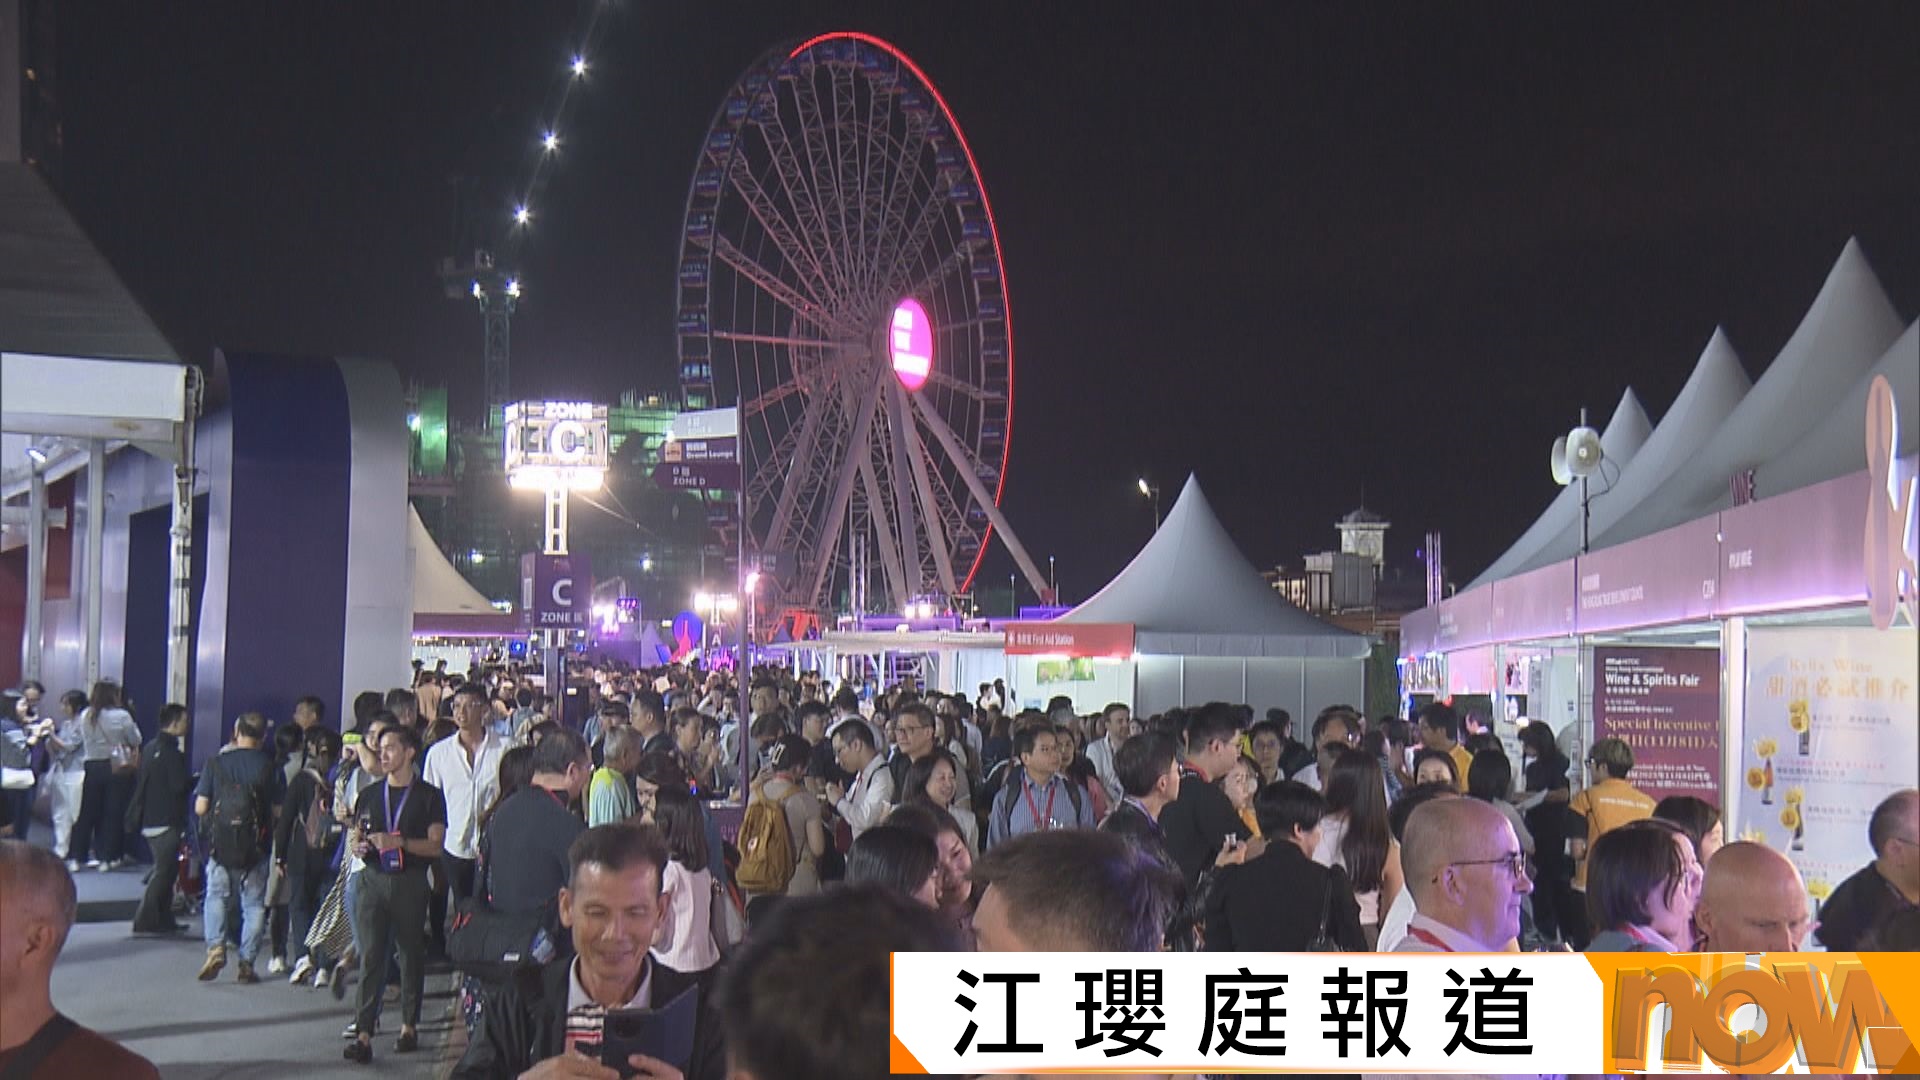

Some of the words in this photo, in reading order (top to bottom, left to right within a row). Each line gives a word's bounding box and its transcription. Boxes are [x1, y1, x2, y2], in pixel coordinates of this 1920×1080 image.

[543, 401, 593, 419] ZONE
[550, 419, 587, 464] C
[672, 477, 698, 487] ZONE
[699, 477, 706, 487] D
[552, 578, 573, 606] C
[541, 612, 571, 624] ZONE
[1032, 632, 1044, 646] First
[1045, 632, 1054, 646] Aid
[1055, 633, 1074, 646] Station
[1605, 674, 1630, 686] Wine
[1632, 674, 1641, 686] &
[1643, 674, 1678, 687] Spirits
[1680, 675, 1700, 687] Fair
[1604, 717, 1650, 732] Special
[1653, 718, 1711, 731] Incentive
